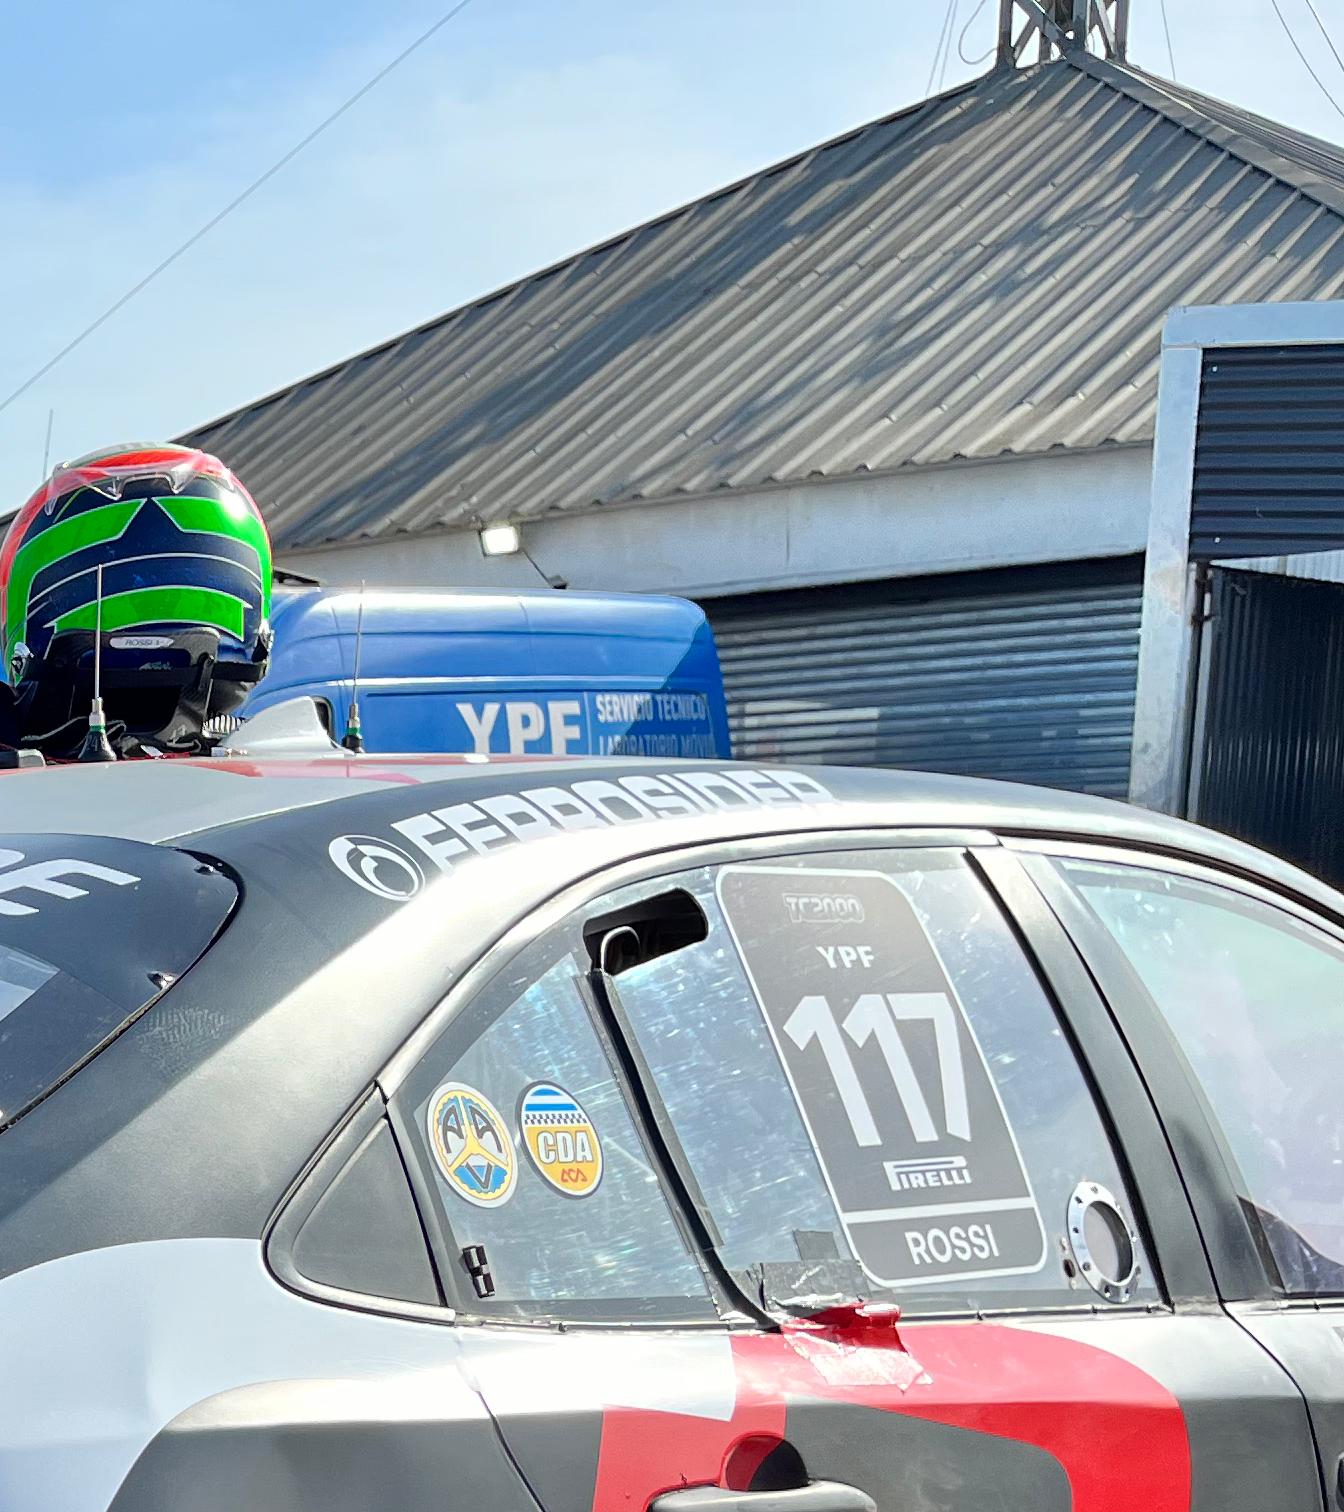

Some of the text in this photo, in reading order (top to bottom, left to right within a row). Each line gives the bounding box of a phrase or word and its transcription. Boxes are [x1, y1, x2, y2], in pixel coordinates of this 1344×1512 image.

[596, 694, 654, 723] SERVICIO
[456, 702, 581, 755] YPF
[815, 945, 875, 969] YPF
[782, 992, 972, 1148] 117
[537, 1130, 596, 1165] CDA
[882, 1155, 973, 1192] PIRELLI
[904, 1223, 1000, 1265] ROSSI
